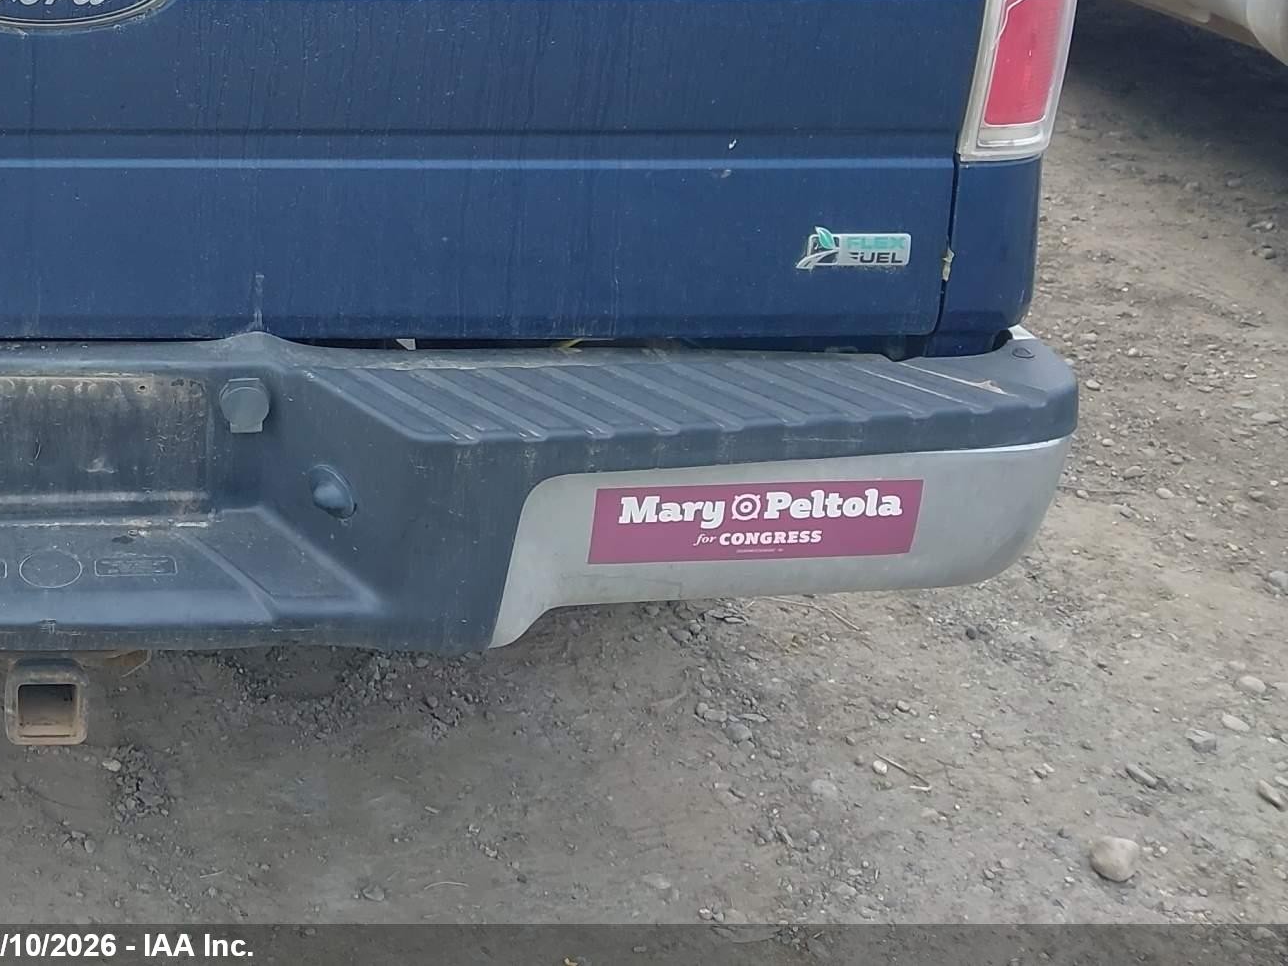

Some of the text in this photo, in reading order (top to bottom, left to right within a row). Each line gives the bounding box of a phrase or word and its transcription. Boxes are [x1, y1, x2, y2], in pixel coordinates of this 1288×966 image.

[846, 237, 906, 250] FLEX
[849, 252, 904, 264] FUEL
[618, 488, 904, 530] Mary Peltola
[693, 530, 823, 547] for CONGRESS
